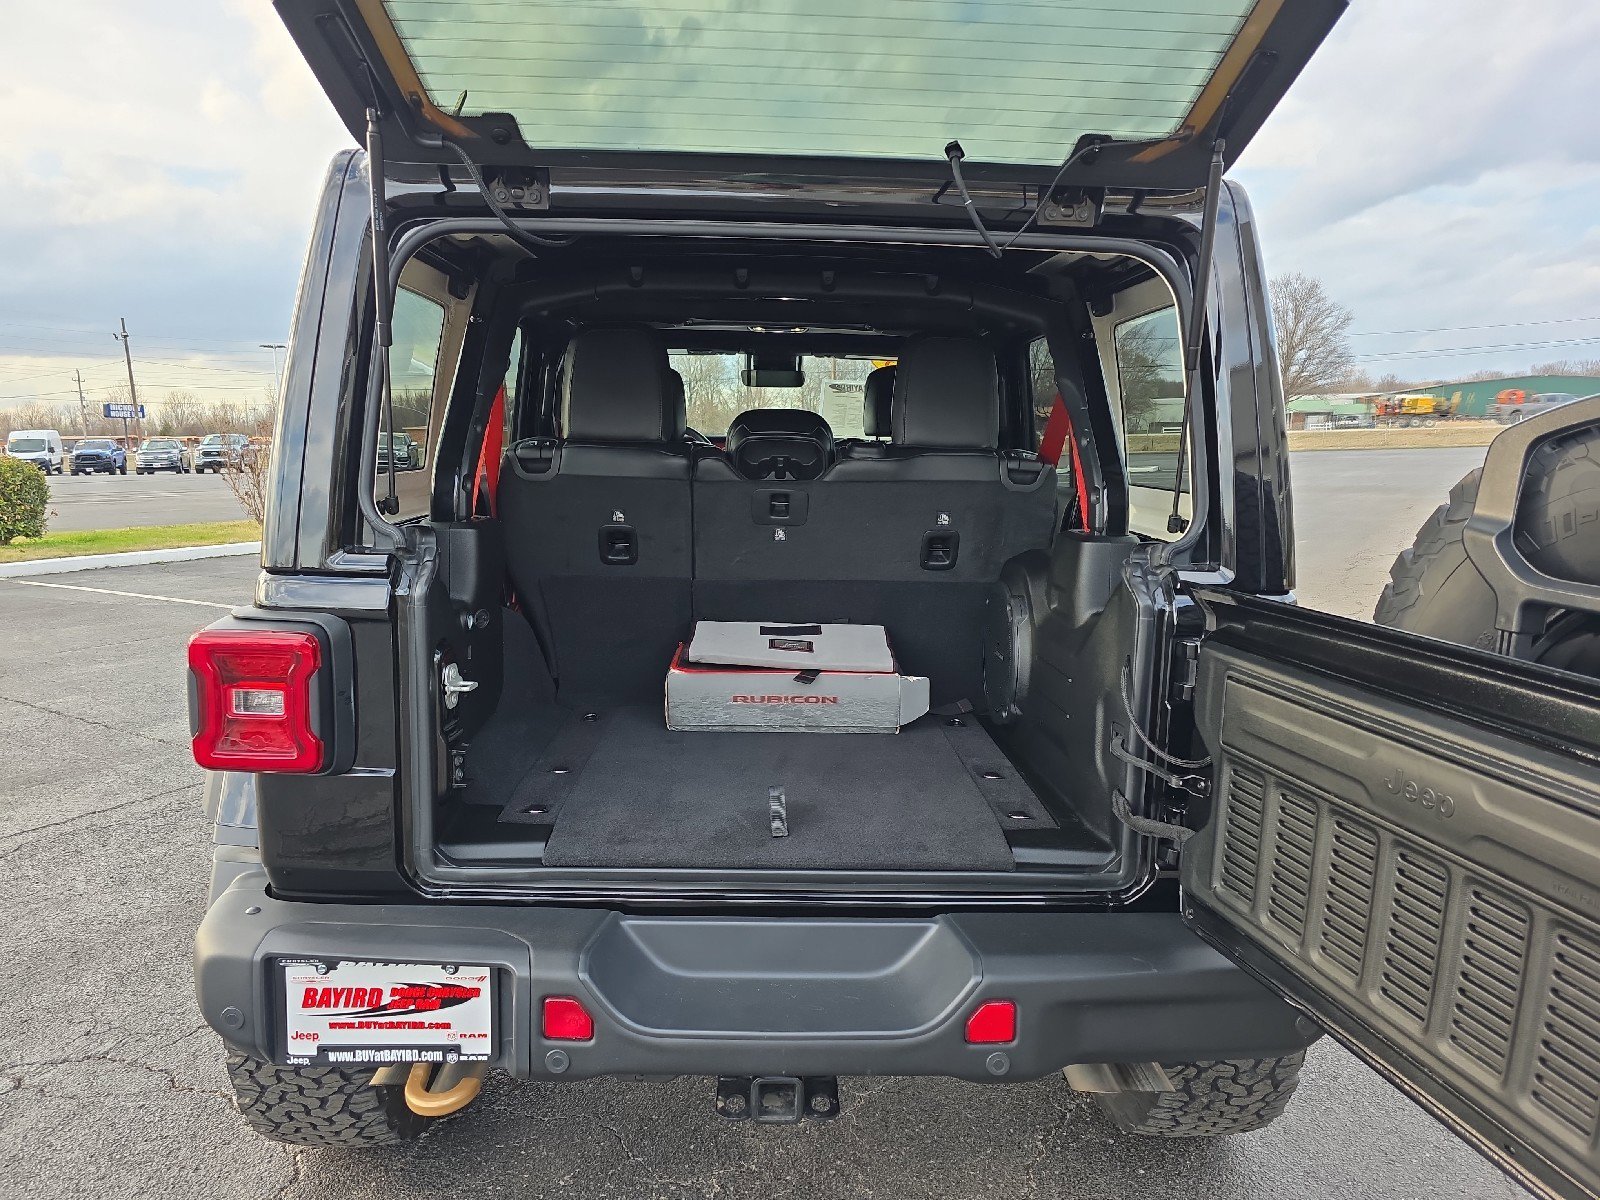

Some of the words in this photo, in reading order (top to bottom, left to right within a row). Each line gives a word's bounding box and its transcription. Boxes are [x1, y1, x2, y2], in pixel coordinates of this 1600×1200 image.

[731, 694, 839, 705] RUBICON
[1383, 768, 1456, 820] Jeep
[301, 987, 384, 1009] BAYIRD
[328, 1020, 452, 1030] www.BUYatBAYIRD.com
[291, 1031, 319, 1042] Jeep
[286, 1056, 310, 1066] Jeep
[328, 1049, 443, 1062] www.BUYatBAYIRD.com
